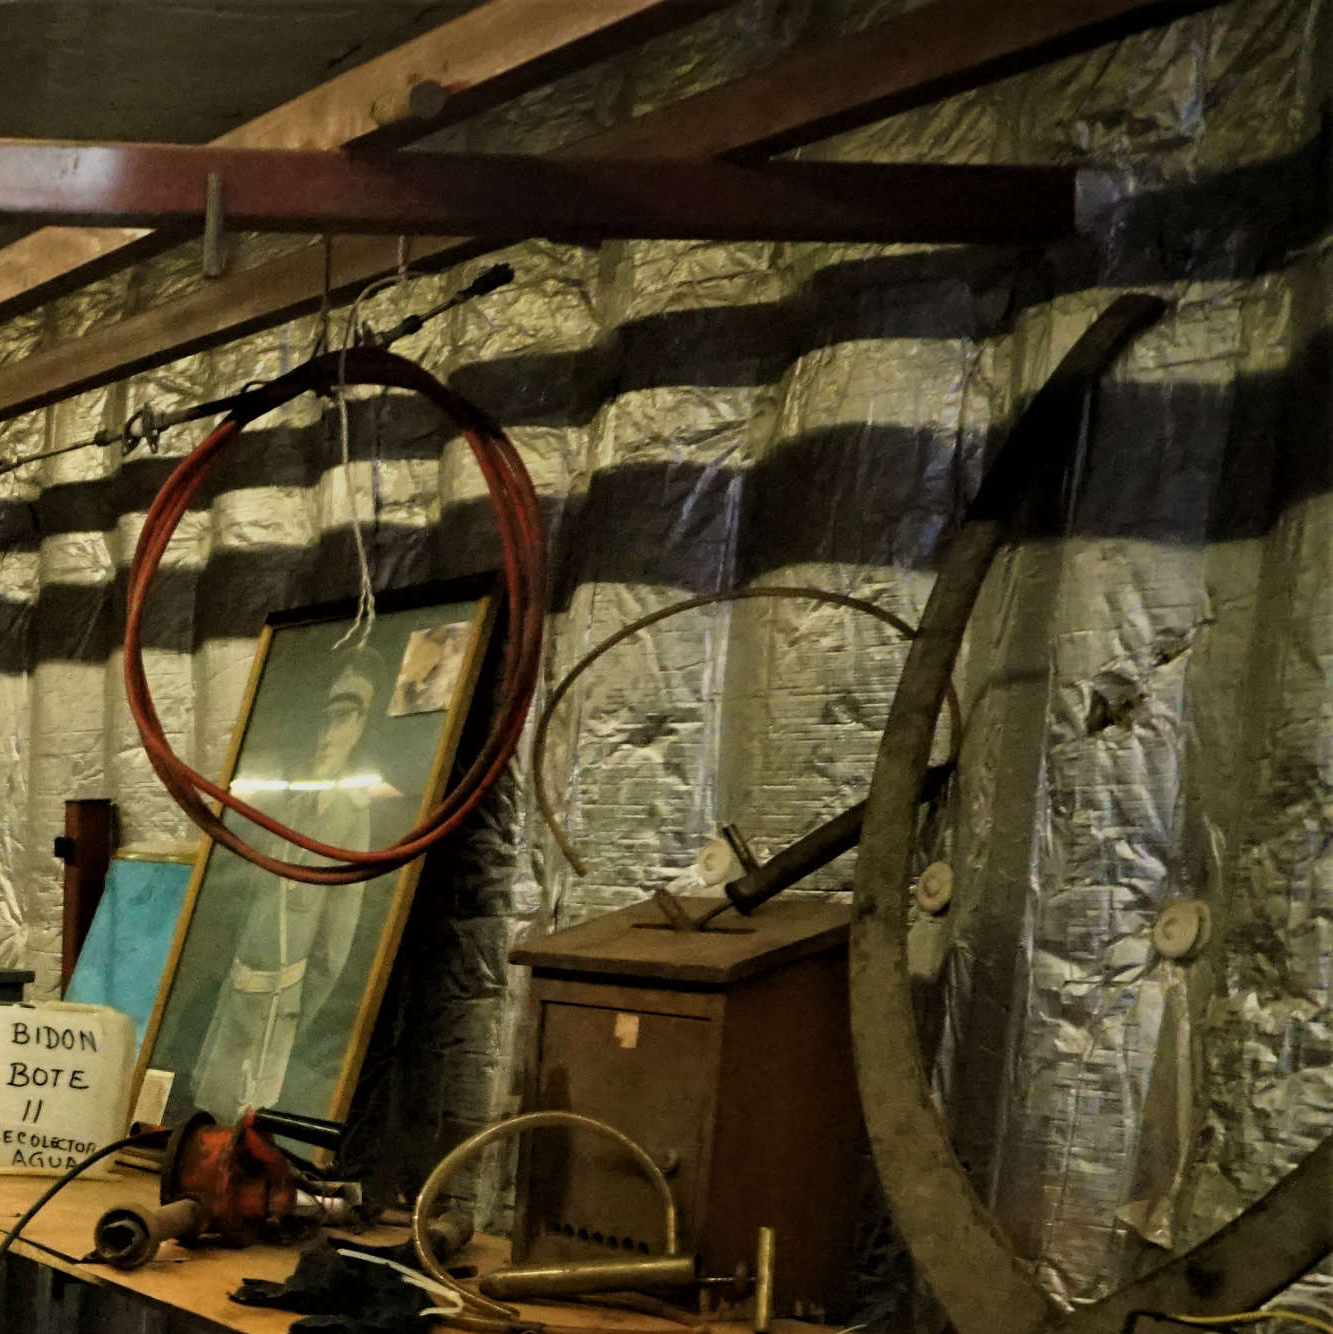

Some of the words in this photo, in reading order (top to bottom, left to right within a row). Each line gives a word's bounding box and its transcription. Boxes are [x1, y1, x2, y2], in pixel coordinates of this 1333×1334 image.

[12, 1022, 97, 1052] BIDON
[7, 1062, 89, 1090] BOTE
[11, 1149, 78, 1169] AGUA
